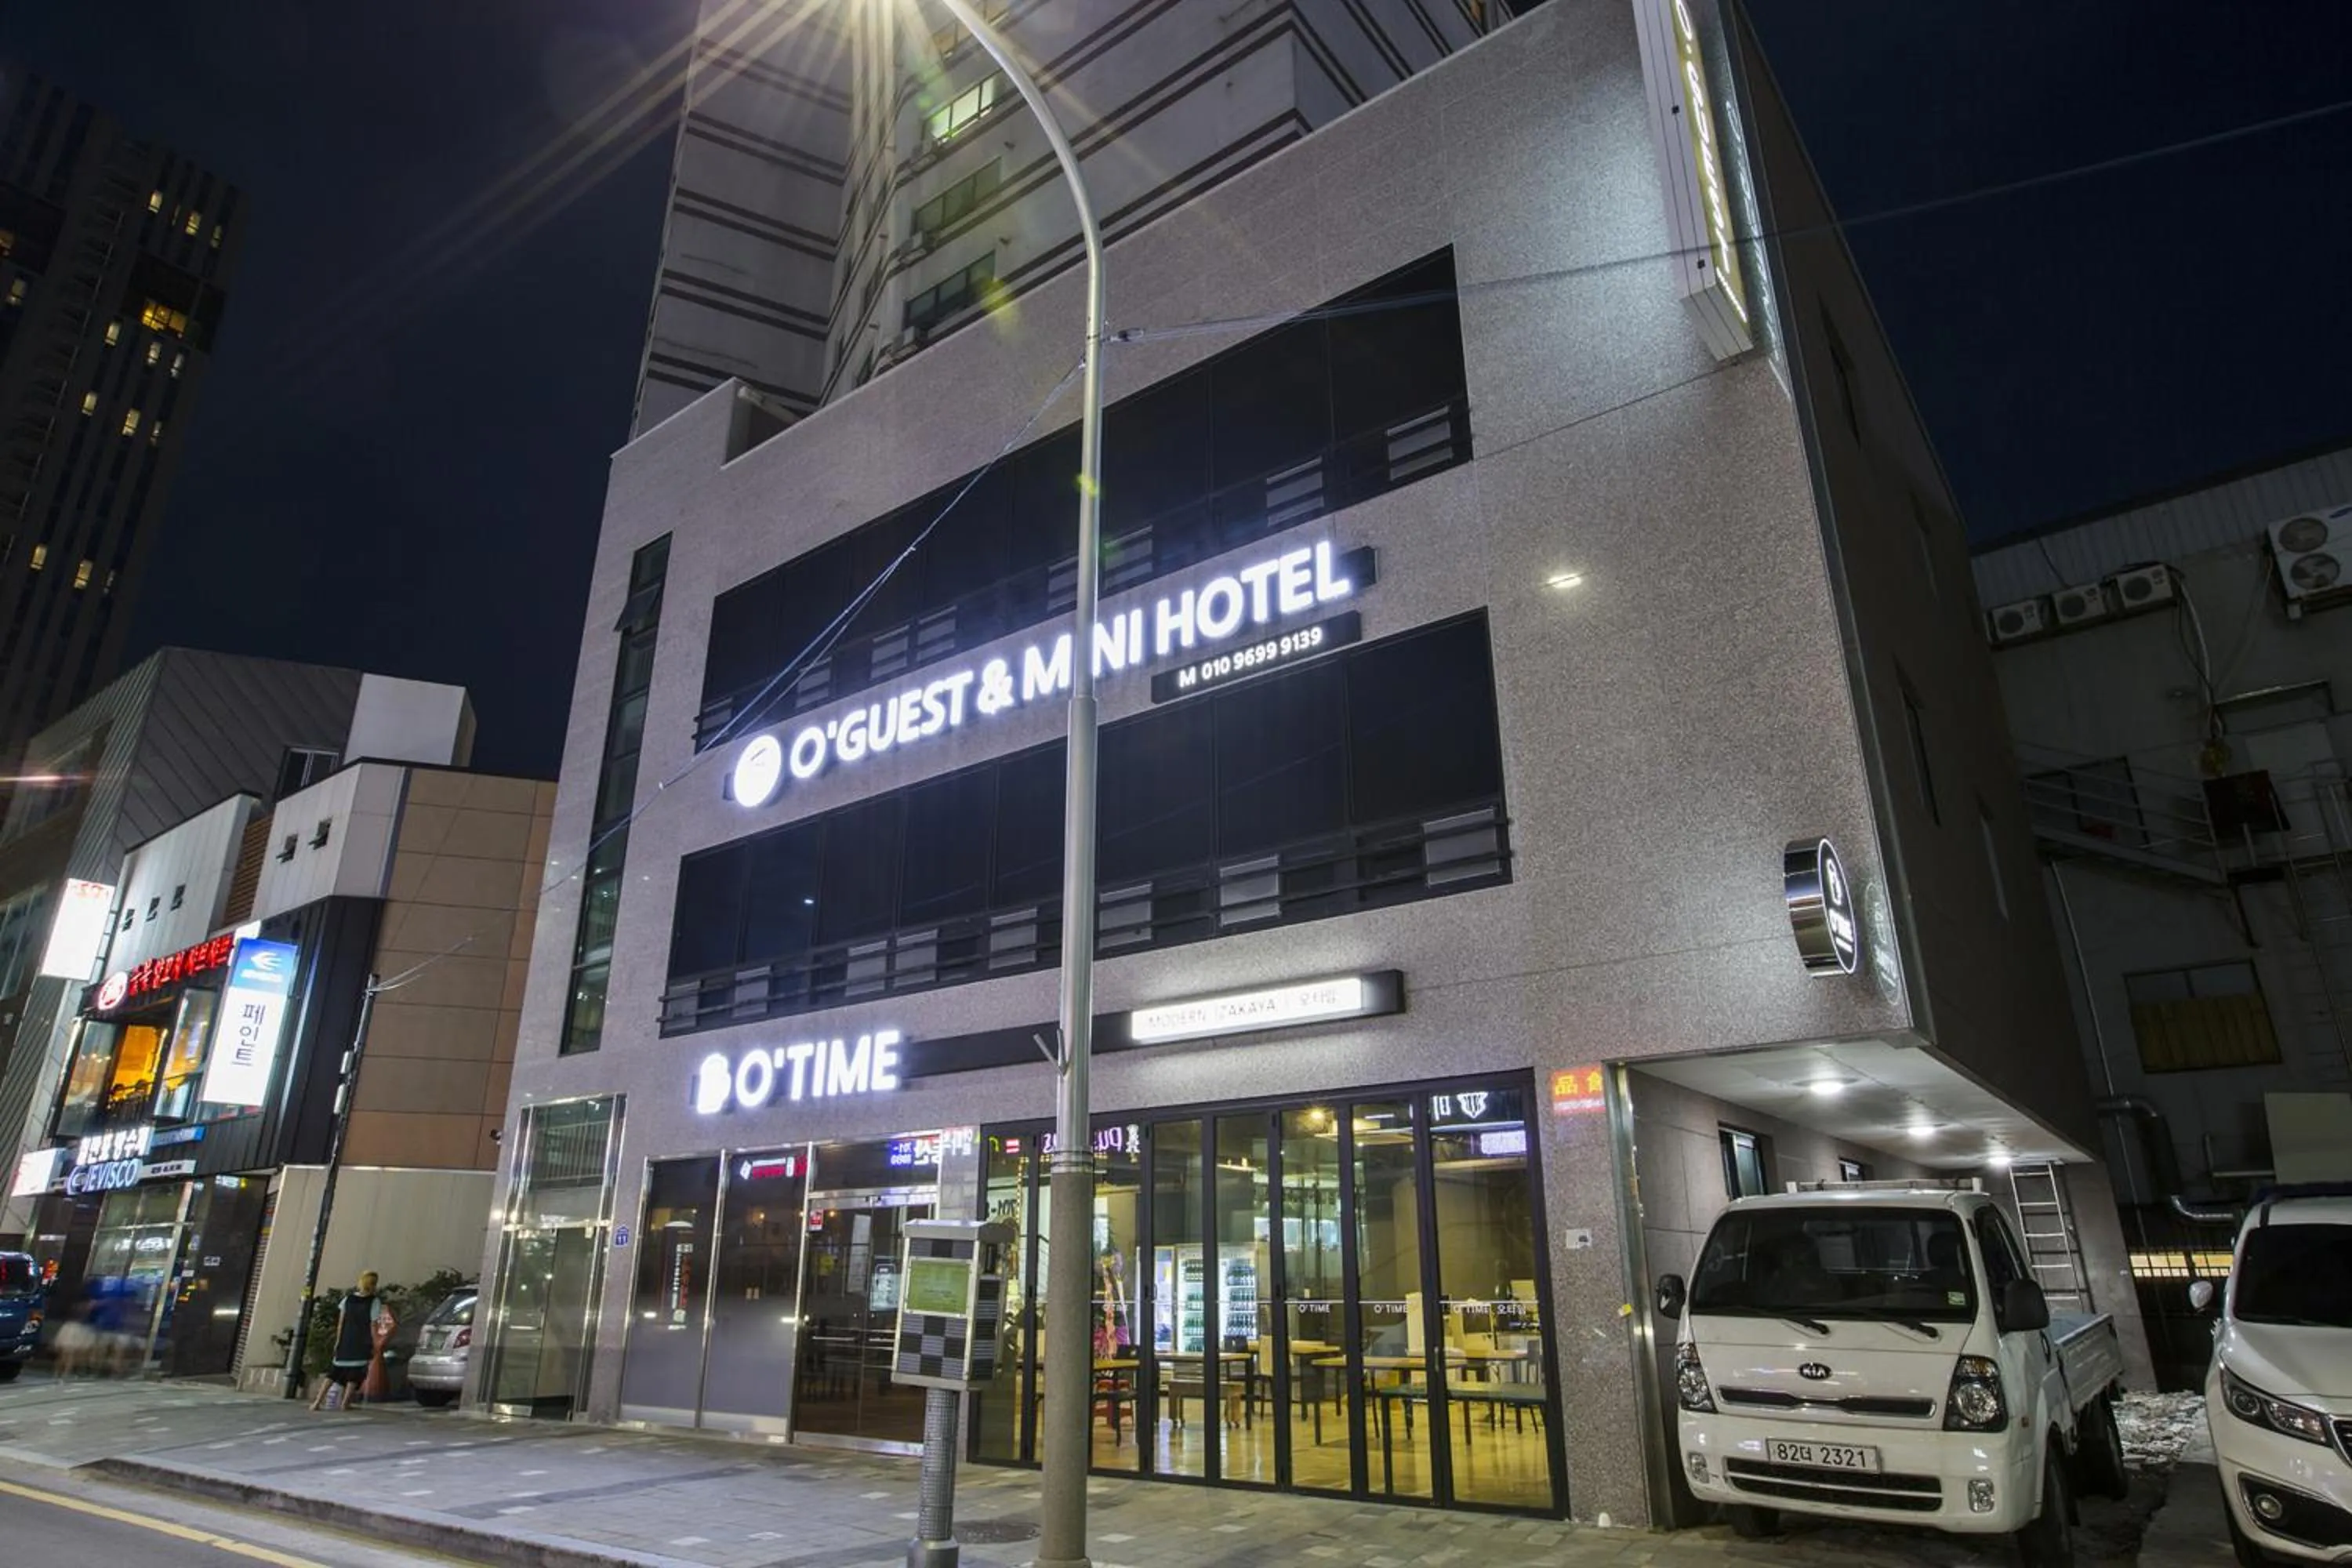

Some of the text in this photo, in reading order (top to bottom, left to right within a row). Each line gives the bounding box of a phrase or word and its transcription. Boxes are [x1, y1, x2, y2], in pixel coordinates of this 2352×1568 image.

[789, 540, 1350, 779] O'GUEST & MNI HOTEL
[1178, 626, 1323, 688] M 010 9699 9139
[231, 1004, 266, 1067] 페인트
[1214, 997, 1277, 1020] IZAKAYA
[735, 1029, 901, 1108] O'TIME
[1802, 1364, 1828, 1377] KIA
[1777, 1443, 1866, 1468] 82더 2321
